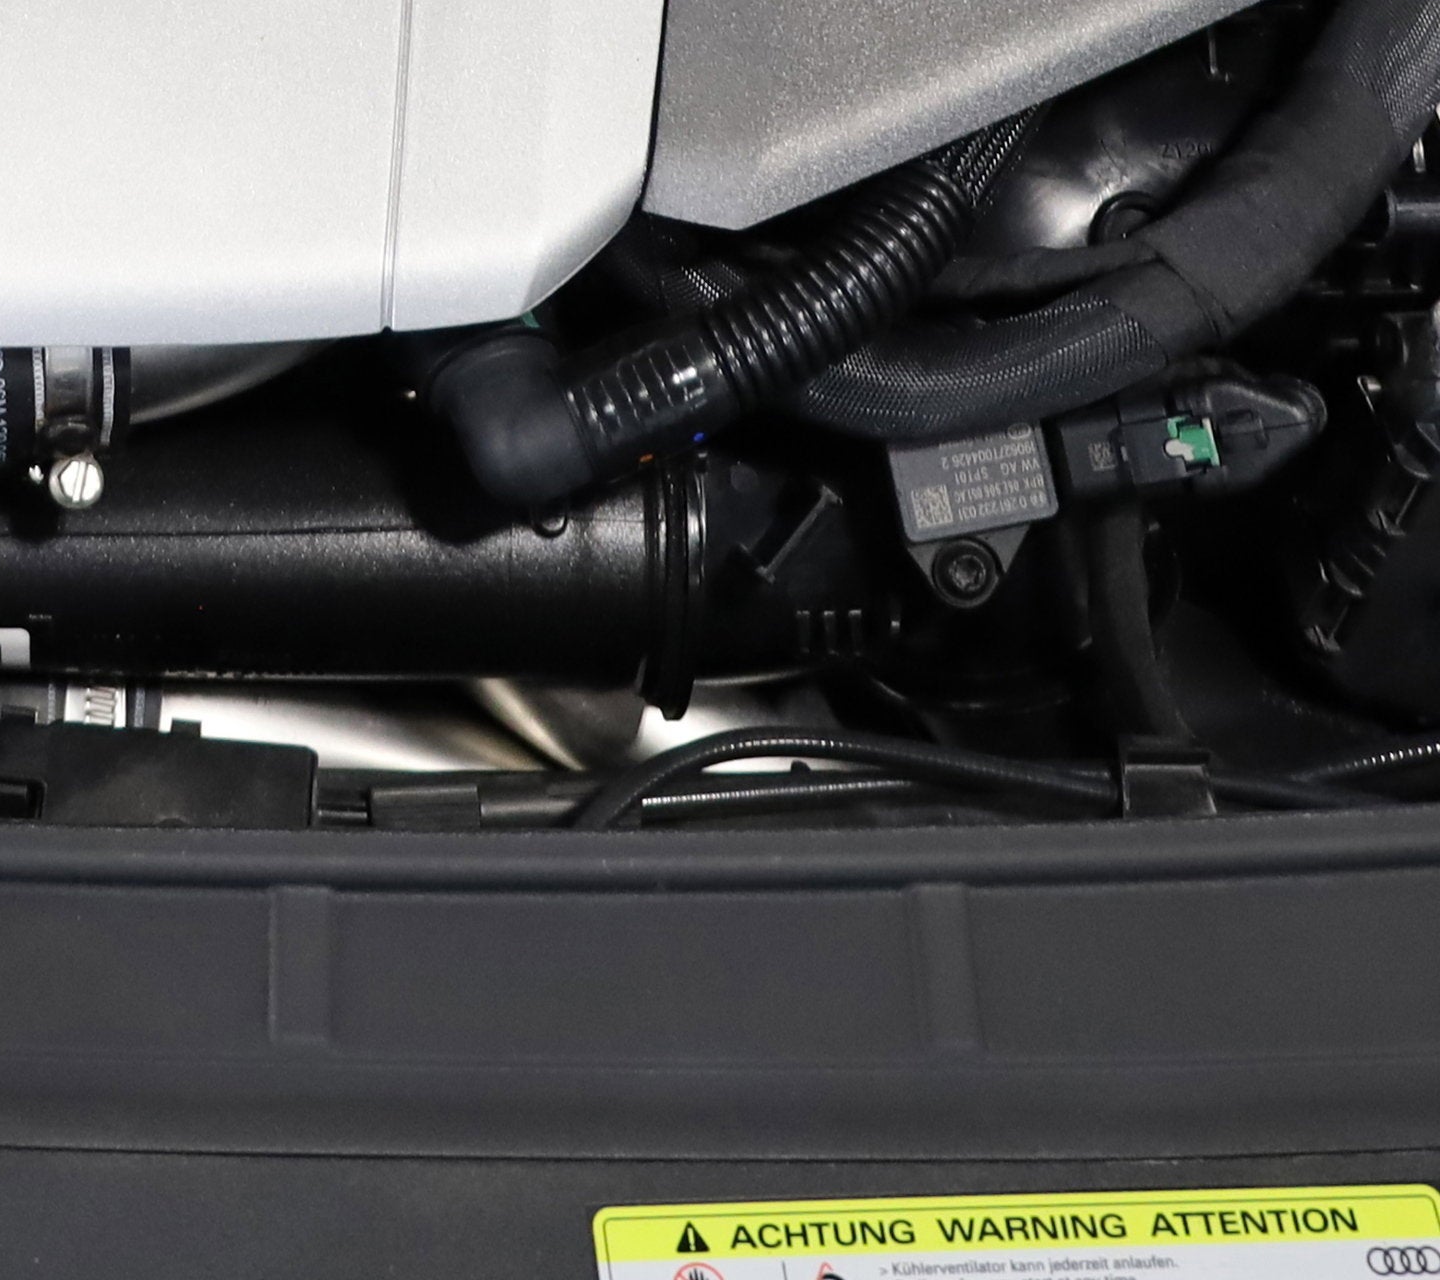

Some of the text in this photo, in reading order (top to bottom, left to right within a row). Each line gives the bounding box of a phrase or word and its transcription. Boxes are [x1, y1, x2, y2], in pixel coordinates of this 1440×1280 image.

[1000, 461, 1018, 476] AG
[1021, 457, 1041, 473] VW
[730, 1207, 1359, 1250] ACHTUNG WARNING ATTENTION
[891, 1259, 1007, 1277] Kühlerventilator
[1009, 1258, 1046, 1273] kann
[1048, 1256, 1109, 1274] jederzeit
